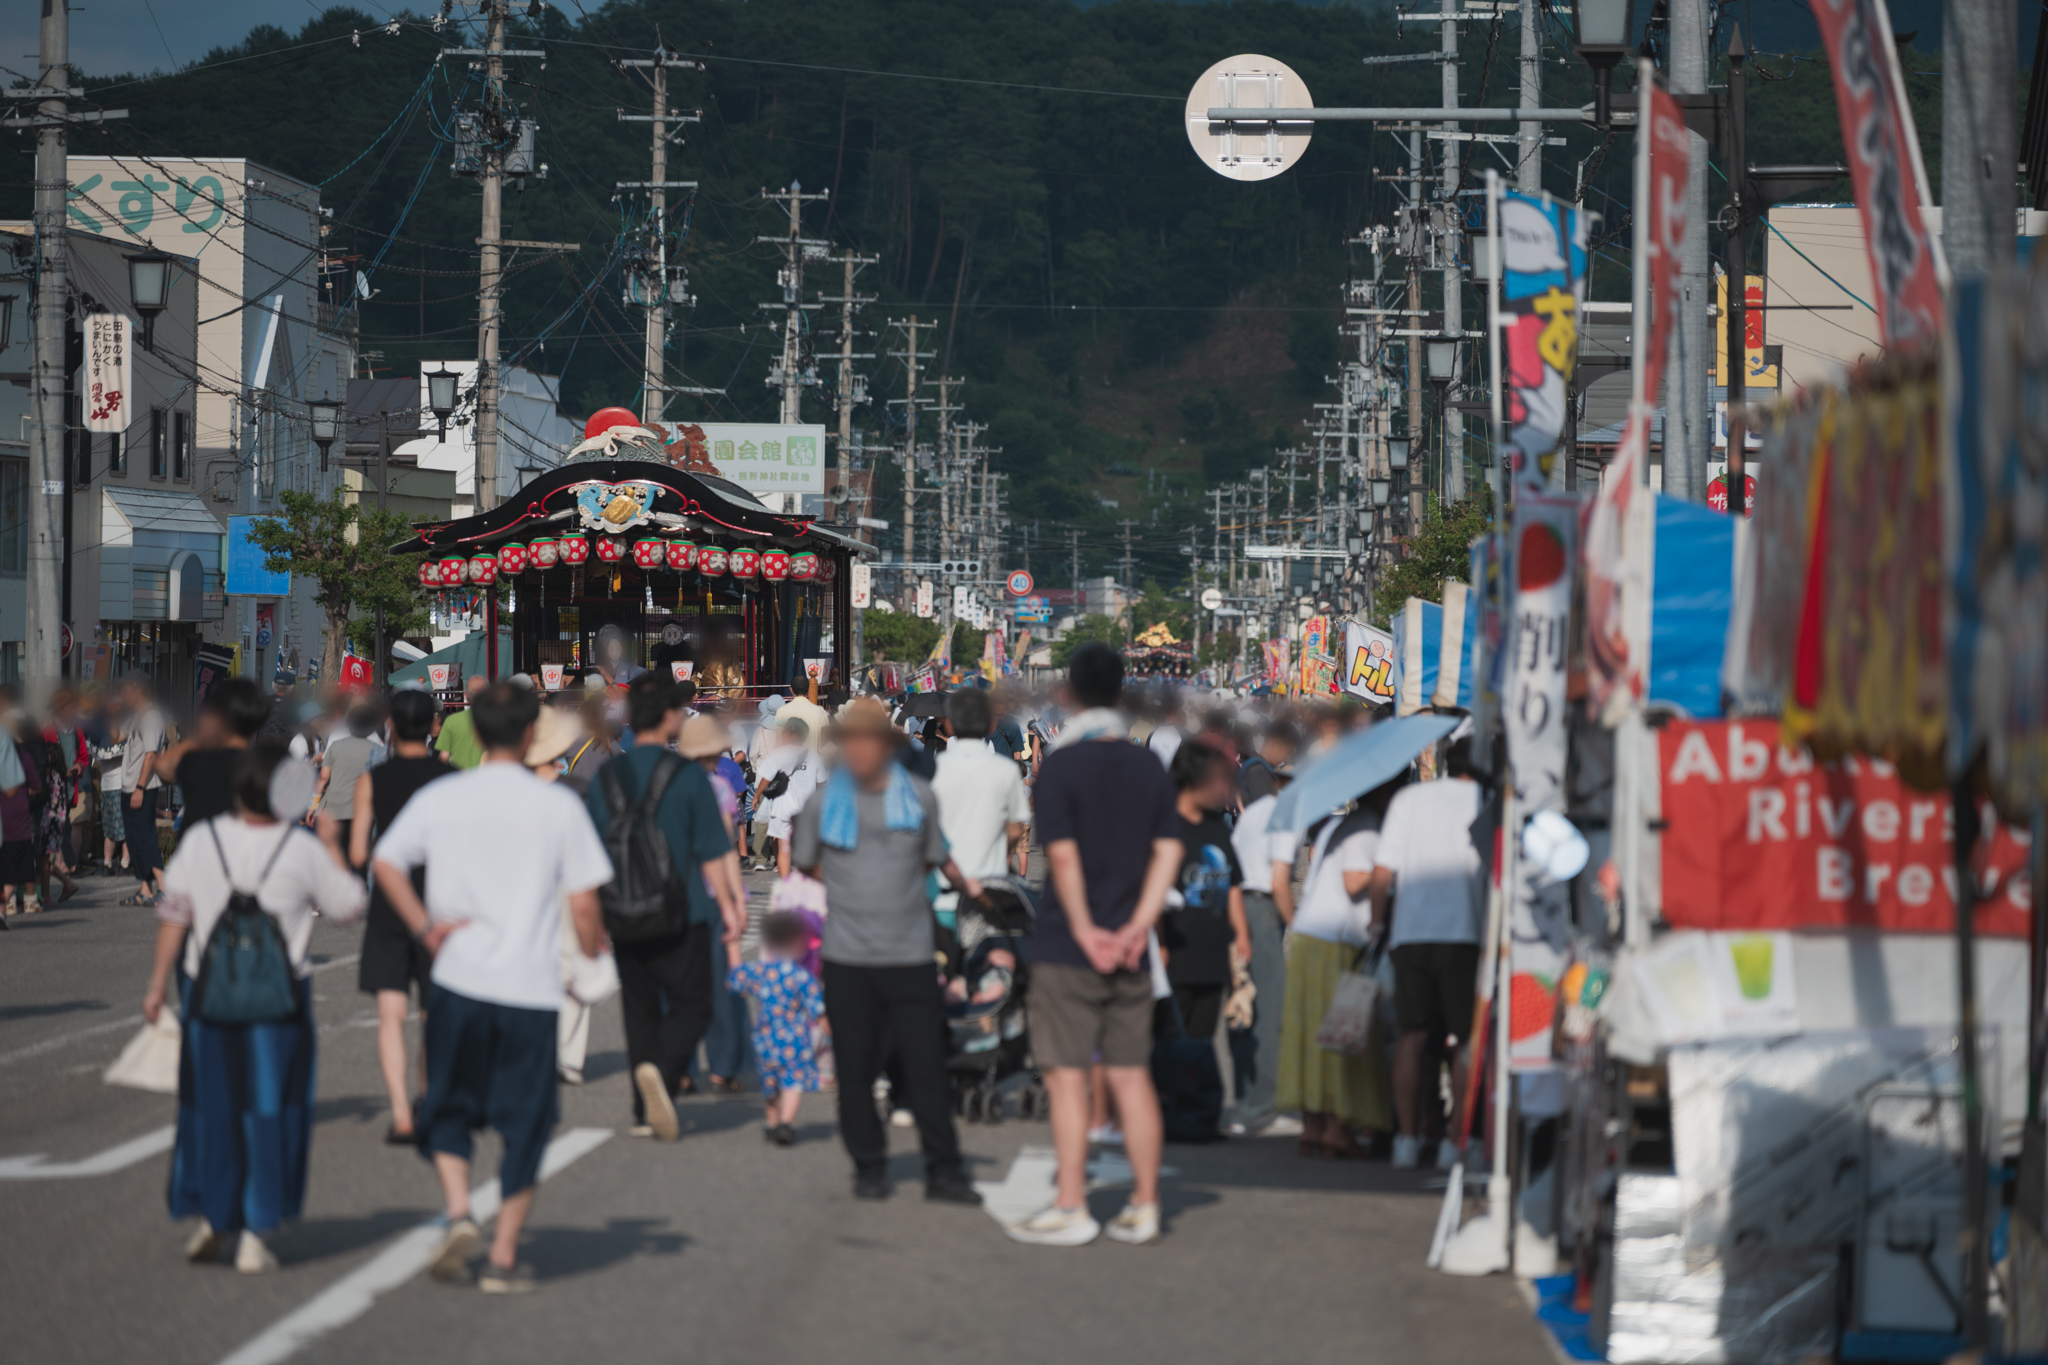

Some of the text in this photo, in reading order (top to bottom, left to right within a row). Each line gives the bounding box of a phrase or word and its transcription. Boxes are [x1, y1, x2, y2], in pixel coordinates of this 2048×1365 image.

[66, 173, 225, 236] くすり
[92, 321, 102, 377] うまいんです
[103, 321, 112, 367] とにかく
[113, 321, 123, 367] 田島の酒
[540, 545, 557, 562] 大
[709, 553, 728, 570] 大
[1013, 577, 1028, 589] 40
[1350, 646, 1395, 698] トル
